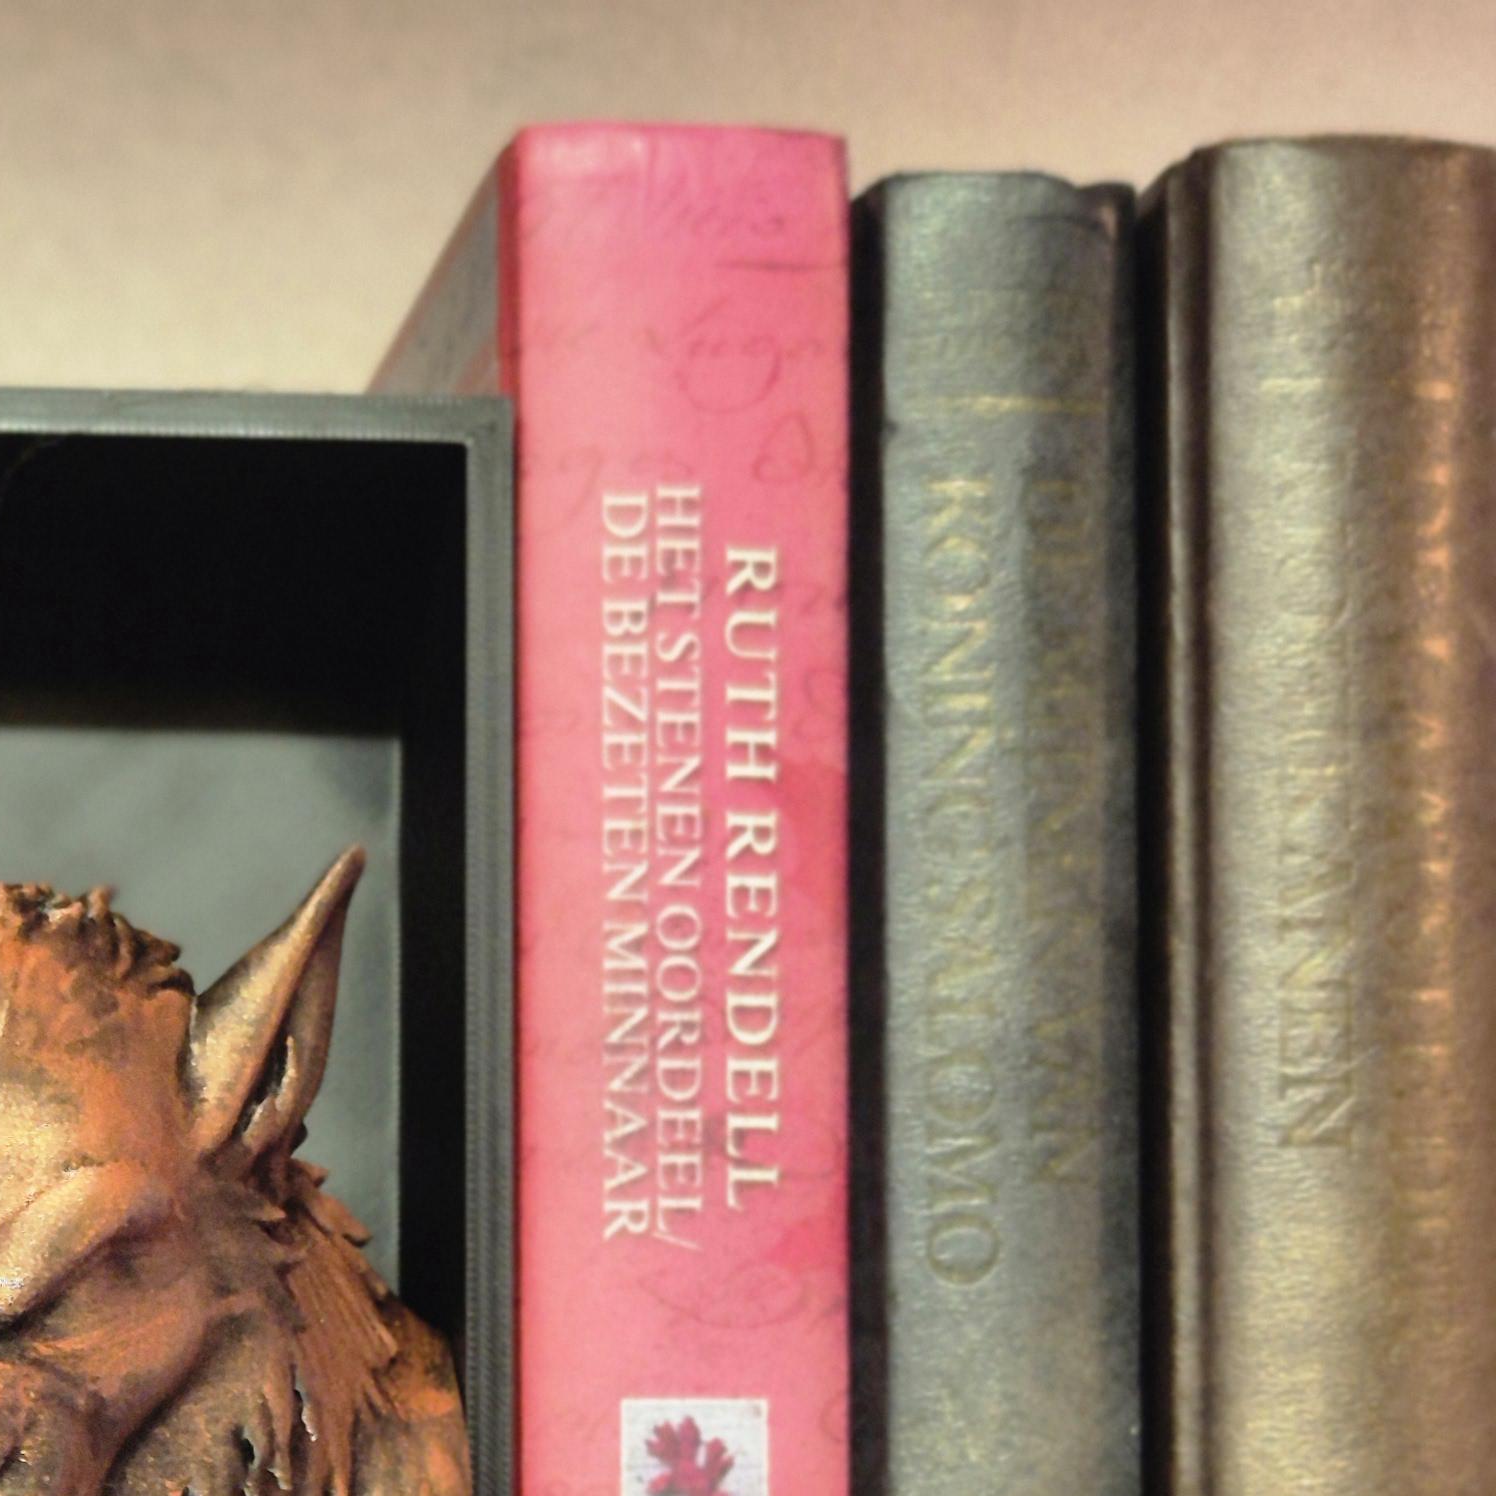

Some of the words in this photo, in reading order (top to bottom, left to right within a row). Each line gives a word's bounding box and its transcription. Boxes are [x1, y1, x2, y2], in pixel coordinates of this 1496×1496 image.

[602, 493, 649, 583] DE
[655, 484, 701, 619] HET
[725, 545, 779, 781] RUTH
[602, 598, 650, 903] BEZETEN
[655, 630, 701, 888] STENEN
[602, 920, 650, 1241] MINNAAR
[725, 810, 780, 1211] RENDELL
